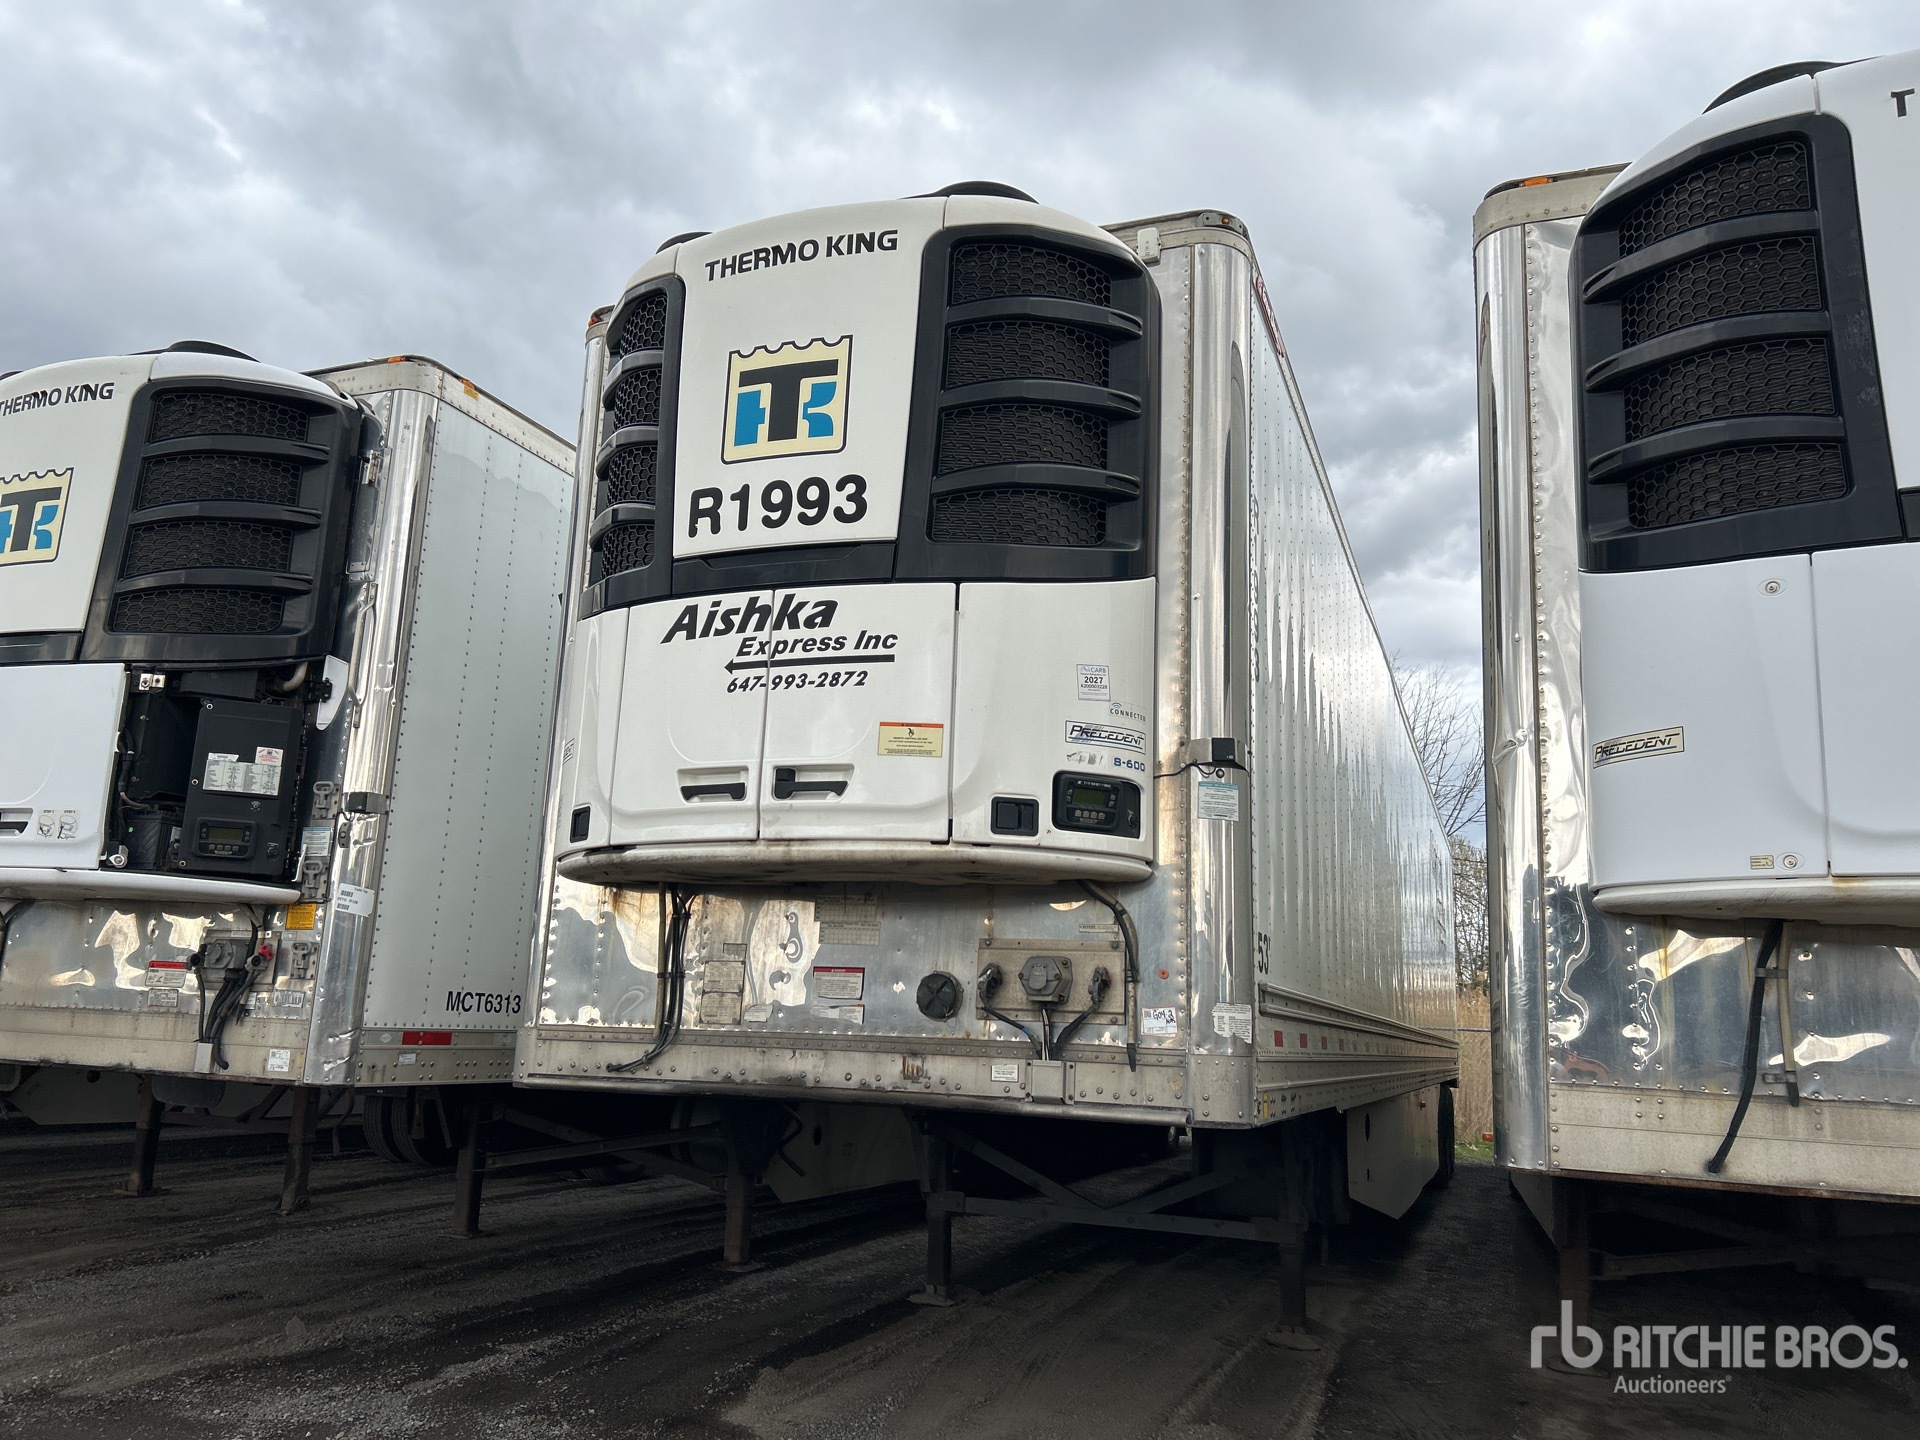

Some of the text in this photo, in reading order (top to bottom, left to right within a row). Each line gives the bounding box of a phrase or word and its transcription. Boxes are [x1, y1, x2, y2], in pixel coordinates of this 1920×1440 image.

[705, 229, 898, 282] THERMO KING
[64, 382, 114, 403] KING
[688, 474, 867, 538] R1993
[660, 593, 838, 644] Aishka
[736, 630, 898, 659] Express Inc
[726, 670, 868, 693] 647-993-2872
[1084, 676, 1104, 684] 2027
[1109, 708, 1146, 722] CONNECTED
[1069, 724, 1145, 745] PRECEDENT
[1594, 733, 1680, 760] PRECEDENT
[446, 991, 521, 1014] MCT6313
